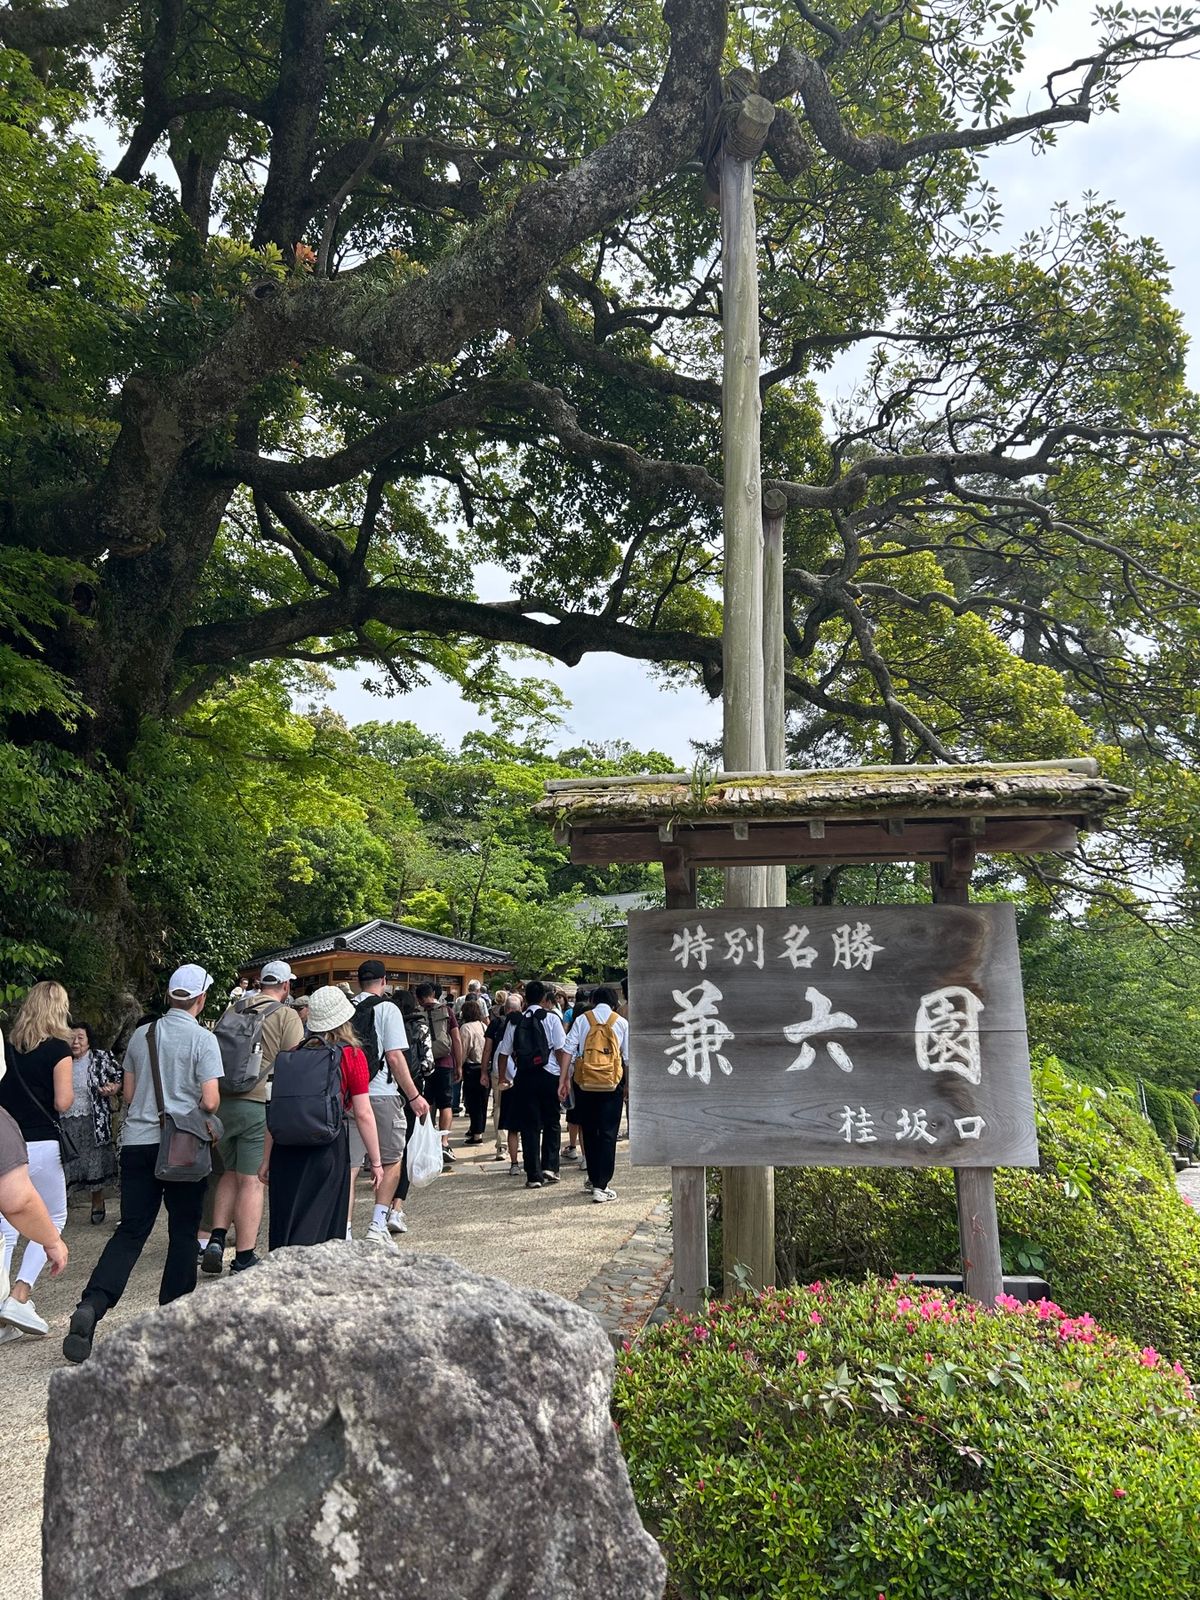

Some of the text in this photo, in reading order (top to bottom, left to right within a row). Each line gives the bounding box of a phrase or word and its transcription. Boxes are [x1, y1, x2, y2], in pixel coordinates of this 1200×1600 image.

[669, 921, 886, 971] 特別名勝
[663, 979, 985, 1085] 兼六園
[838, 1105, 987, 1145] 桂坂口
